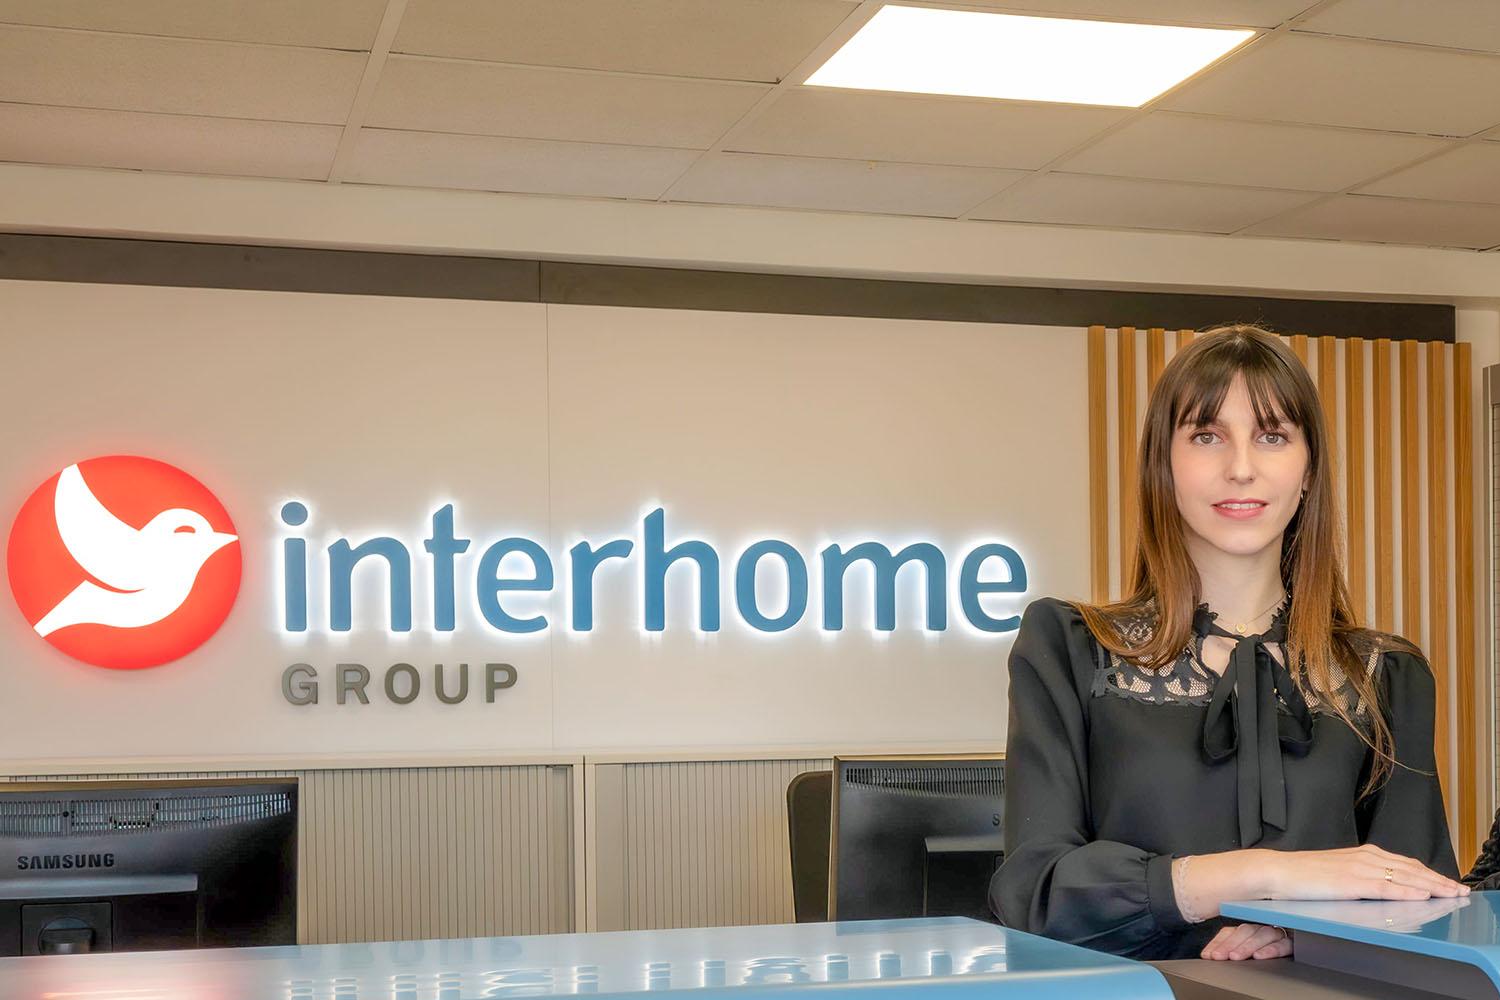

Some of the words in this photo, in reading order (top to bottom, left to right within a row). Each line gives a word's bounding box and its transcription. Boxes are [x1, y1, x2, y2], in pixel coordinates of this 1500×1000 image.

[280, 502, 1028, 633] interhome
[282, 664, 518, 705] GROUP
[17, 853, 114, 870] SAMSUNG
